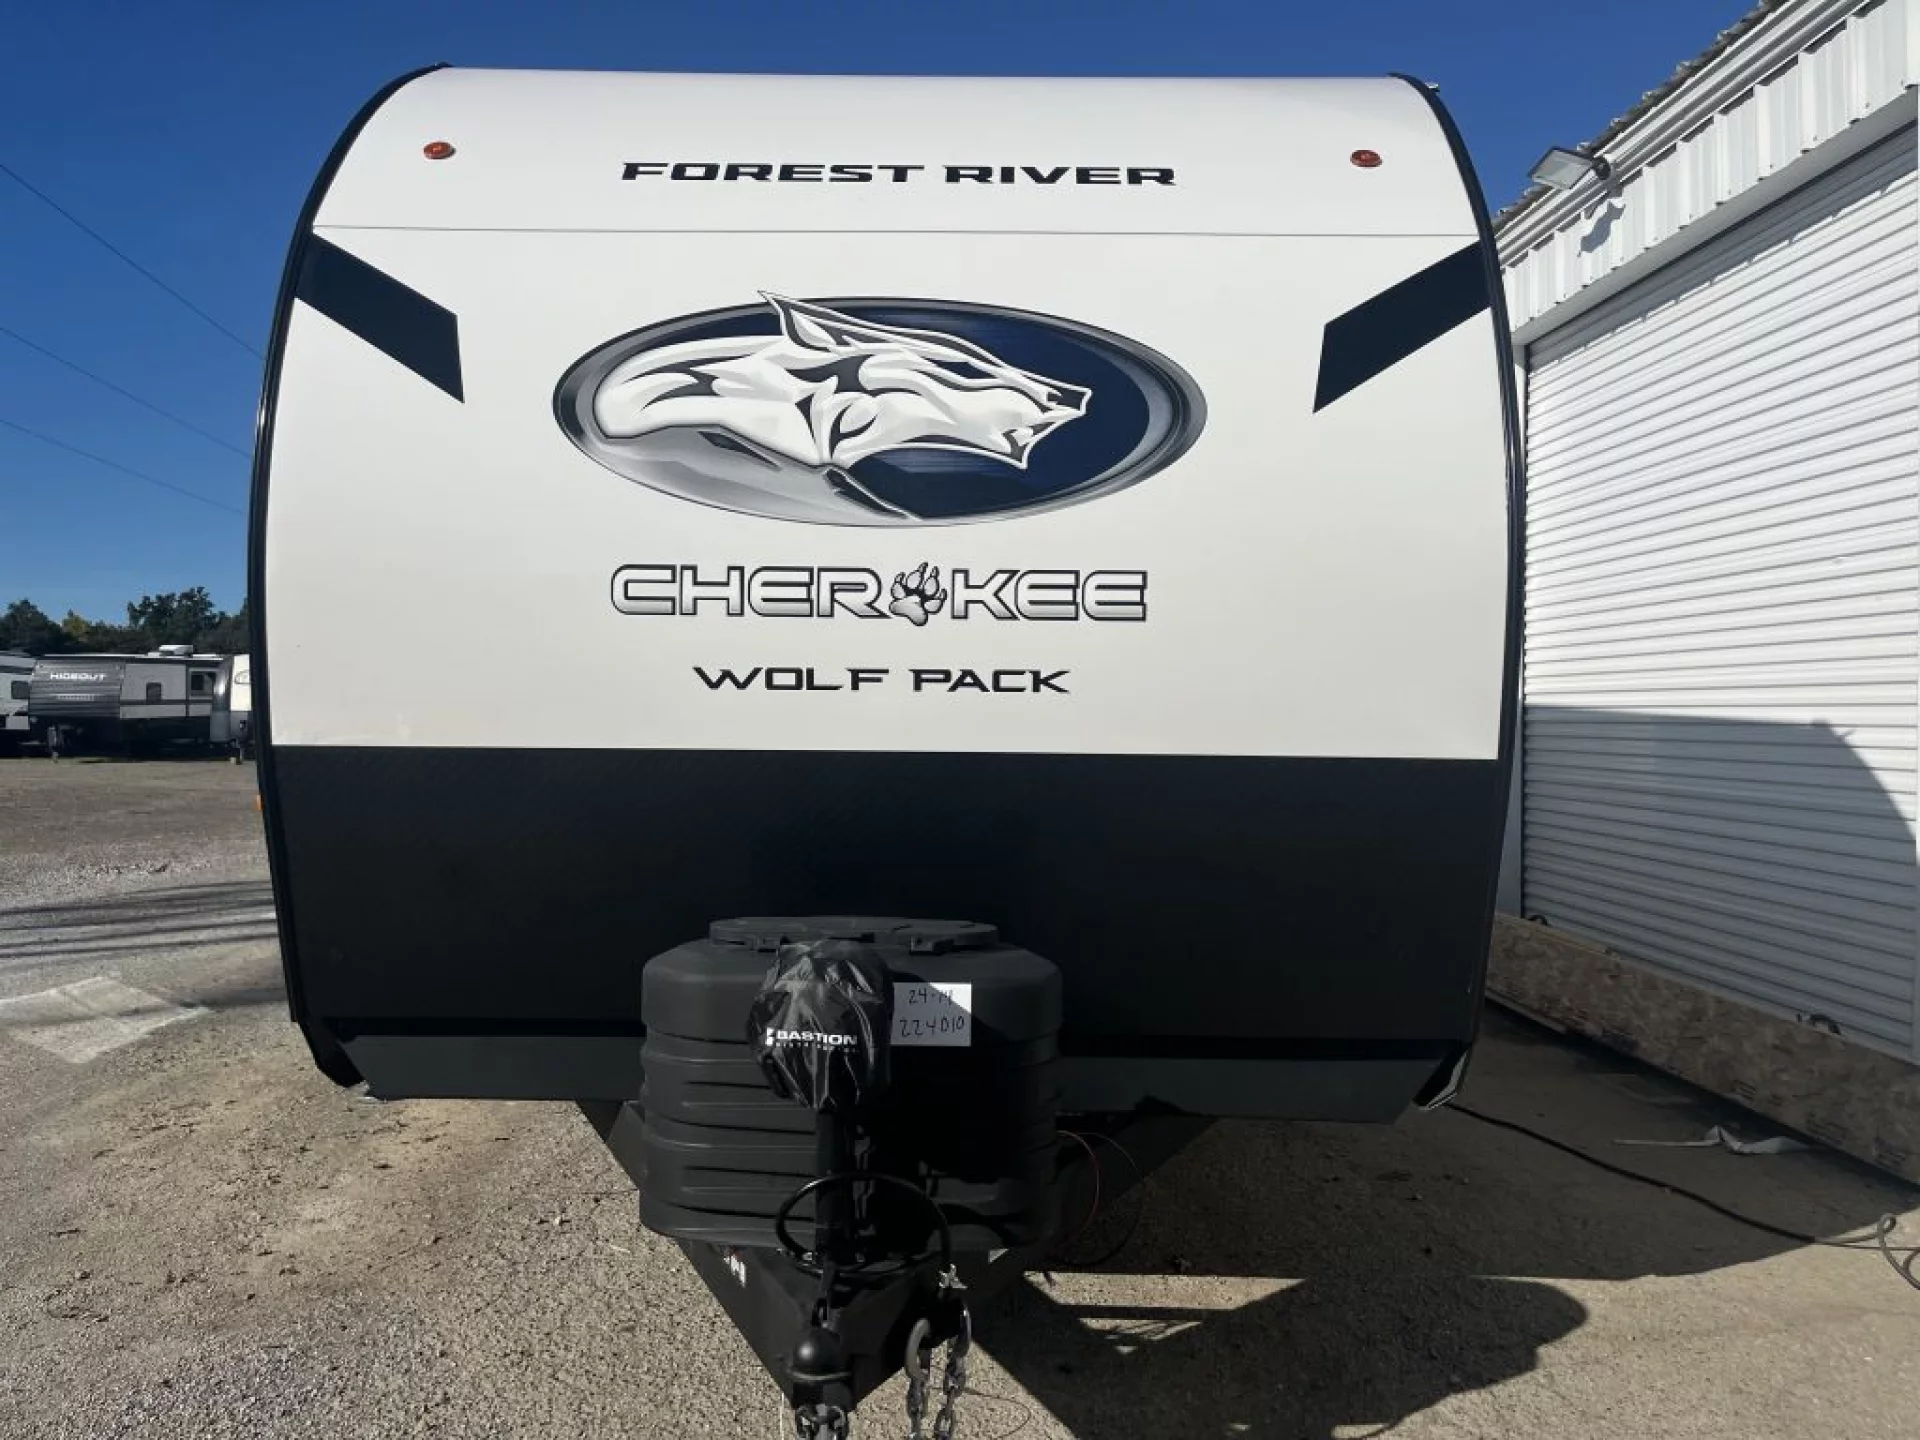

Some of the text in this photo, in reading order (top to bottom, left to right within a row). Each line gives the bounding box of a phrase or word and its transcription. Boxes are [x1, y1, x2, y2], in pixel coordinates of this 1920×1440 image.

[622, 162, 1177, 186] FOREST RIVER
[50, 672, 107, 681] HIDEOUT
[693, 666, 1071, 694] WOLF PACK
[777, 1030, 858, 1045] BASTION
